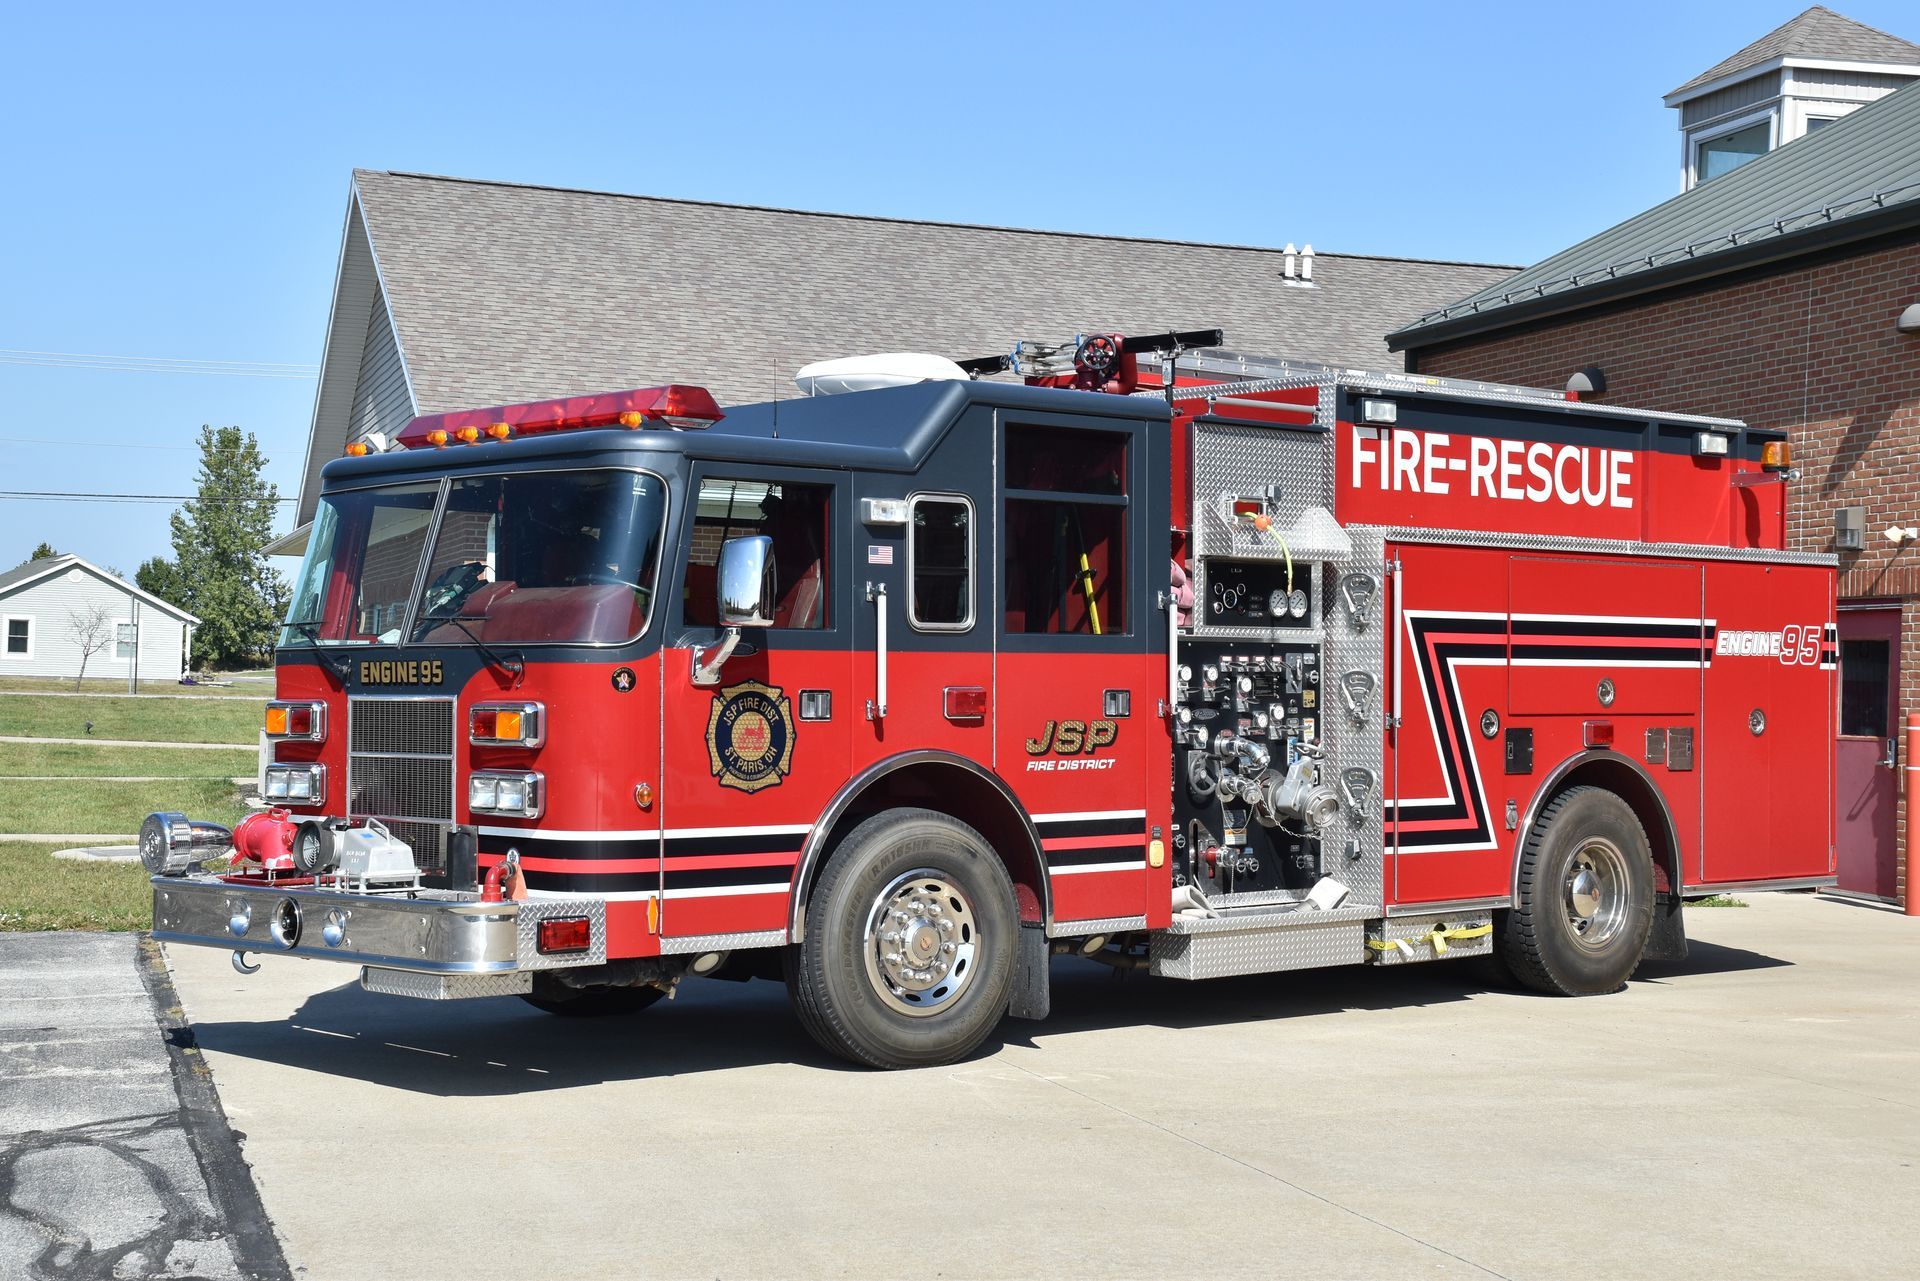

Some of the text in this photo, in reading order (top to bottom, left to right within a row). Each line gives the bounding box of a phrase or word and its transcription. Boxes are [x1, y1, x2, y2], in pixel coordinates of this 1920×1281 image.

[1352, 426, 1634, 509] FIRE-RESCUE
[1715, 624, 1821, 665] ENGINE 95
[360, 660, 443, 684] ENGINE 95
[723, 698, 780, 726] JSP FIRE DIST.
[1025, 720, 1118, 756] JSP
[724, 746, 738, 765] ST.
[736, 760, 767, 773] PARIS,
[765, 746, 778, 763] OH
[1026, 759, 1116, 771] FIRE DISTRICT
